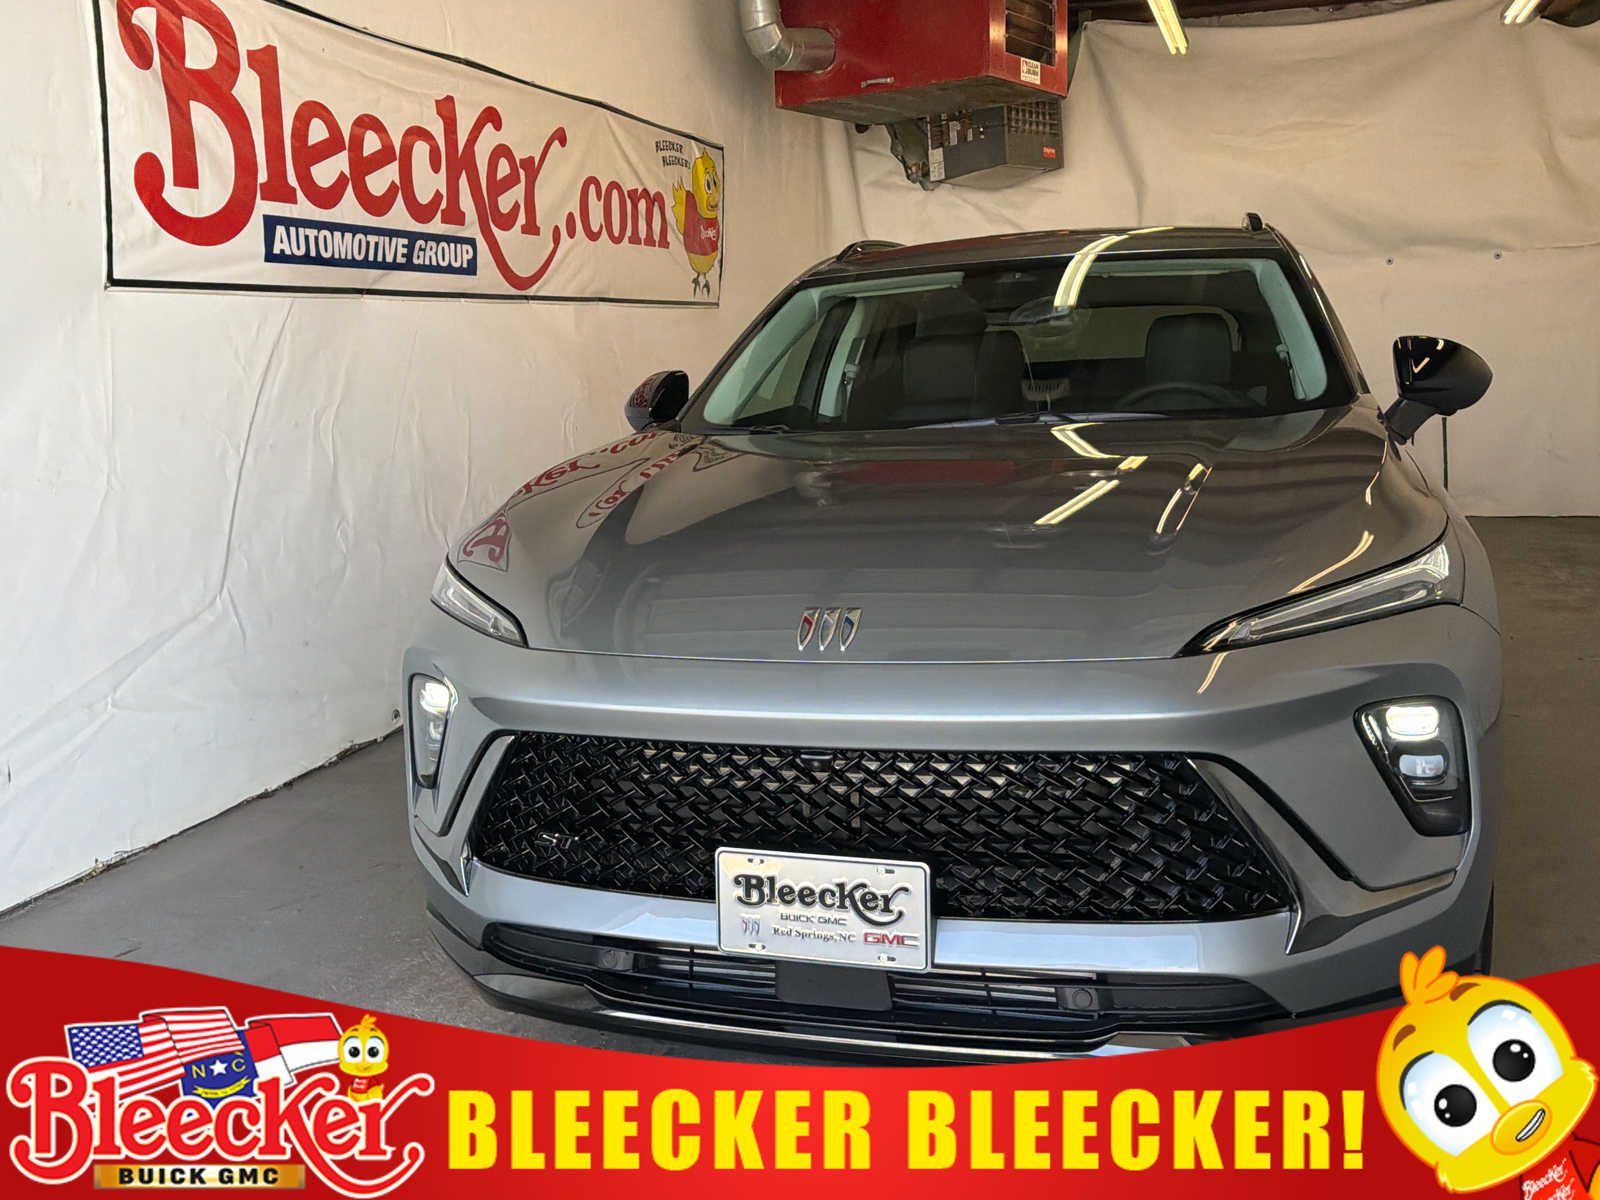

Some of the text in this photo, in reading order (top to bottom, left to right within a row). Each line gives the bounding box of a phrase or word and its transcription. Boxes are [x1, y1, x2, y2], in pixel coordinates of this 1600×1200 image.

[655, 140, 683, 153] BLEECKER
[272, 224, 474, 268] AUTOMOTIVE GROUP
[734, 873, 909, 927] Bleecker
[780, 912, 848, 926] BUICK GMC
[772, 927, 792, 937] Red
[863, 931, 919, 947] GMC
